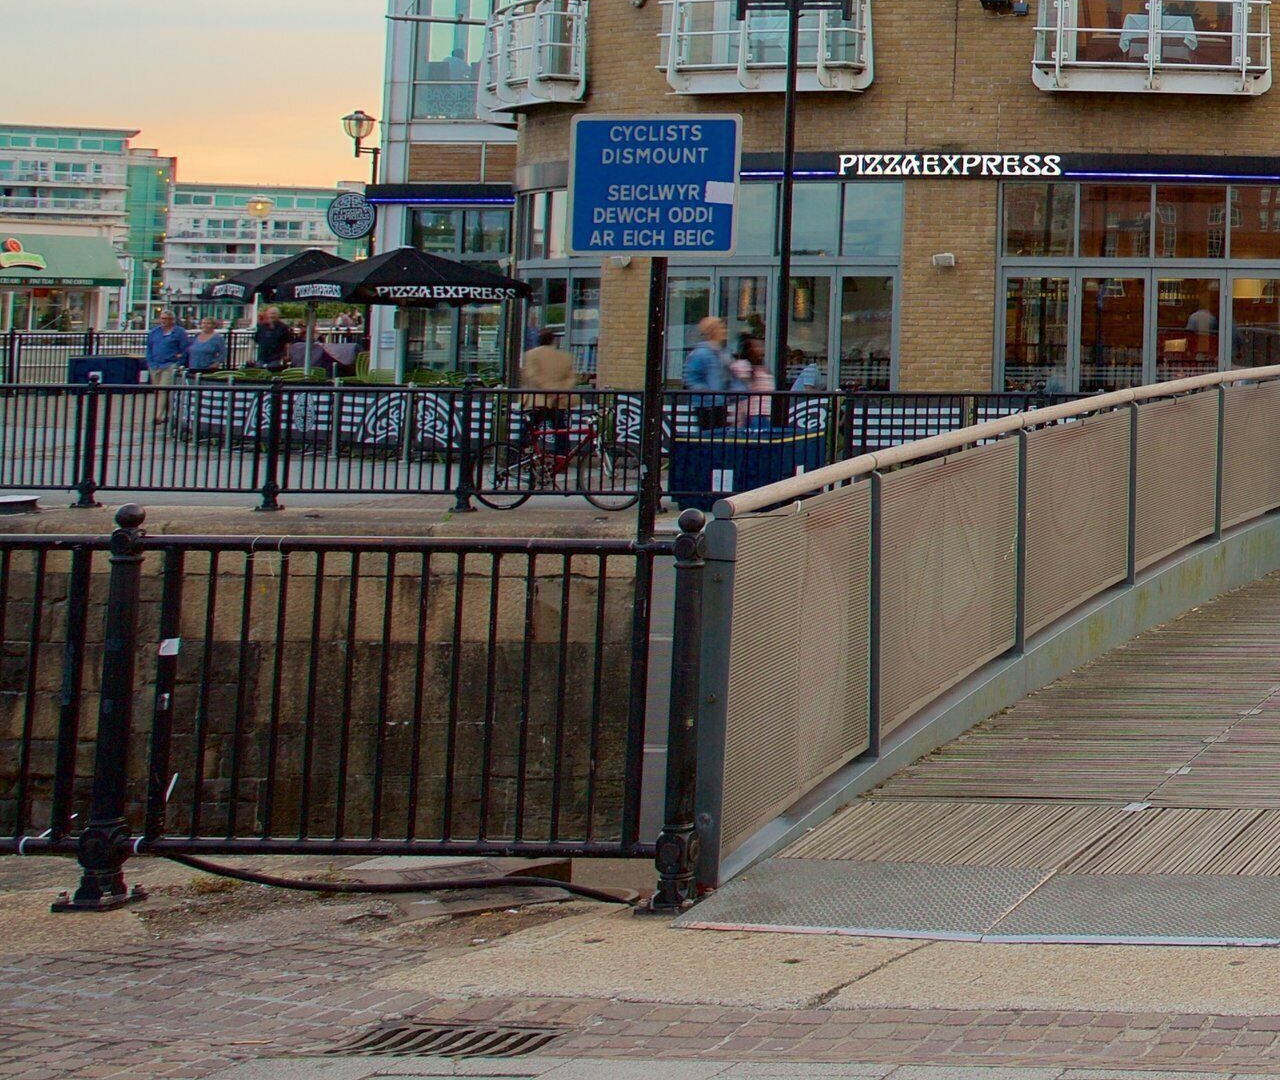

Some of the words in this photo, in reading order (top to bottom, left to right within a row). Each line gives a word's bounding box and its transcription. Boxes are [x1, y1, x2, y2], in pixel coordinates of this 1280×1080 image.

[609, 124, 703, 143] CYCLISTS
[601, 147, 709, 165] DISMOUNT
[607, 184, 700, 202] SEICLWYR
[592, 207, 661, 224] DEWCH
[667, 206, 713, 224] ODDI
[589, 230, 615, 247] AR
[622, 229, 666, 246] EICH
[673, 229, 716, 246] BEIC
